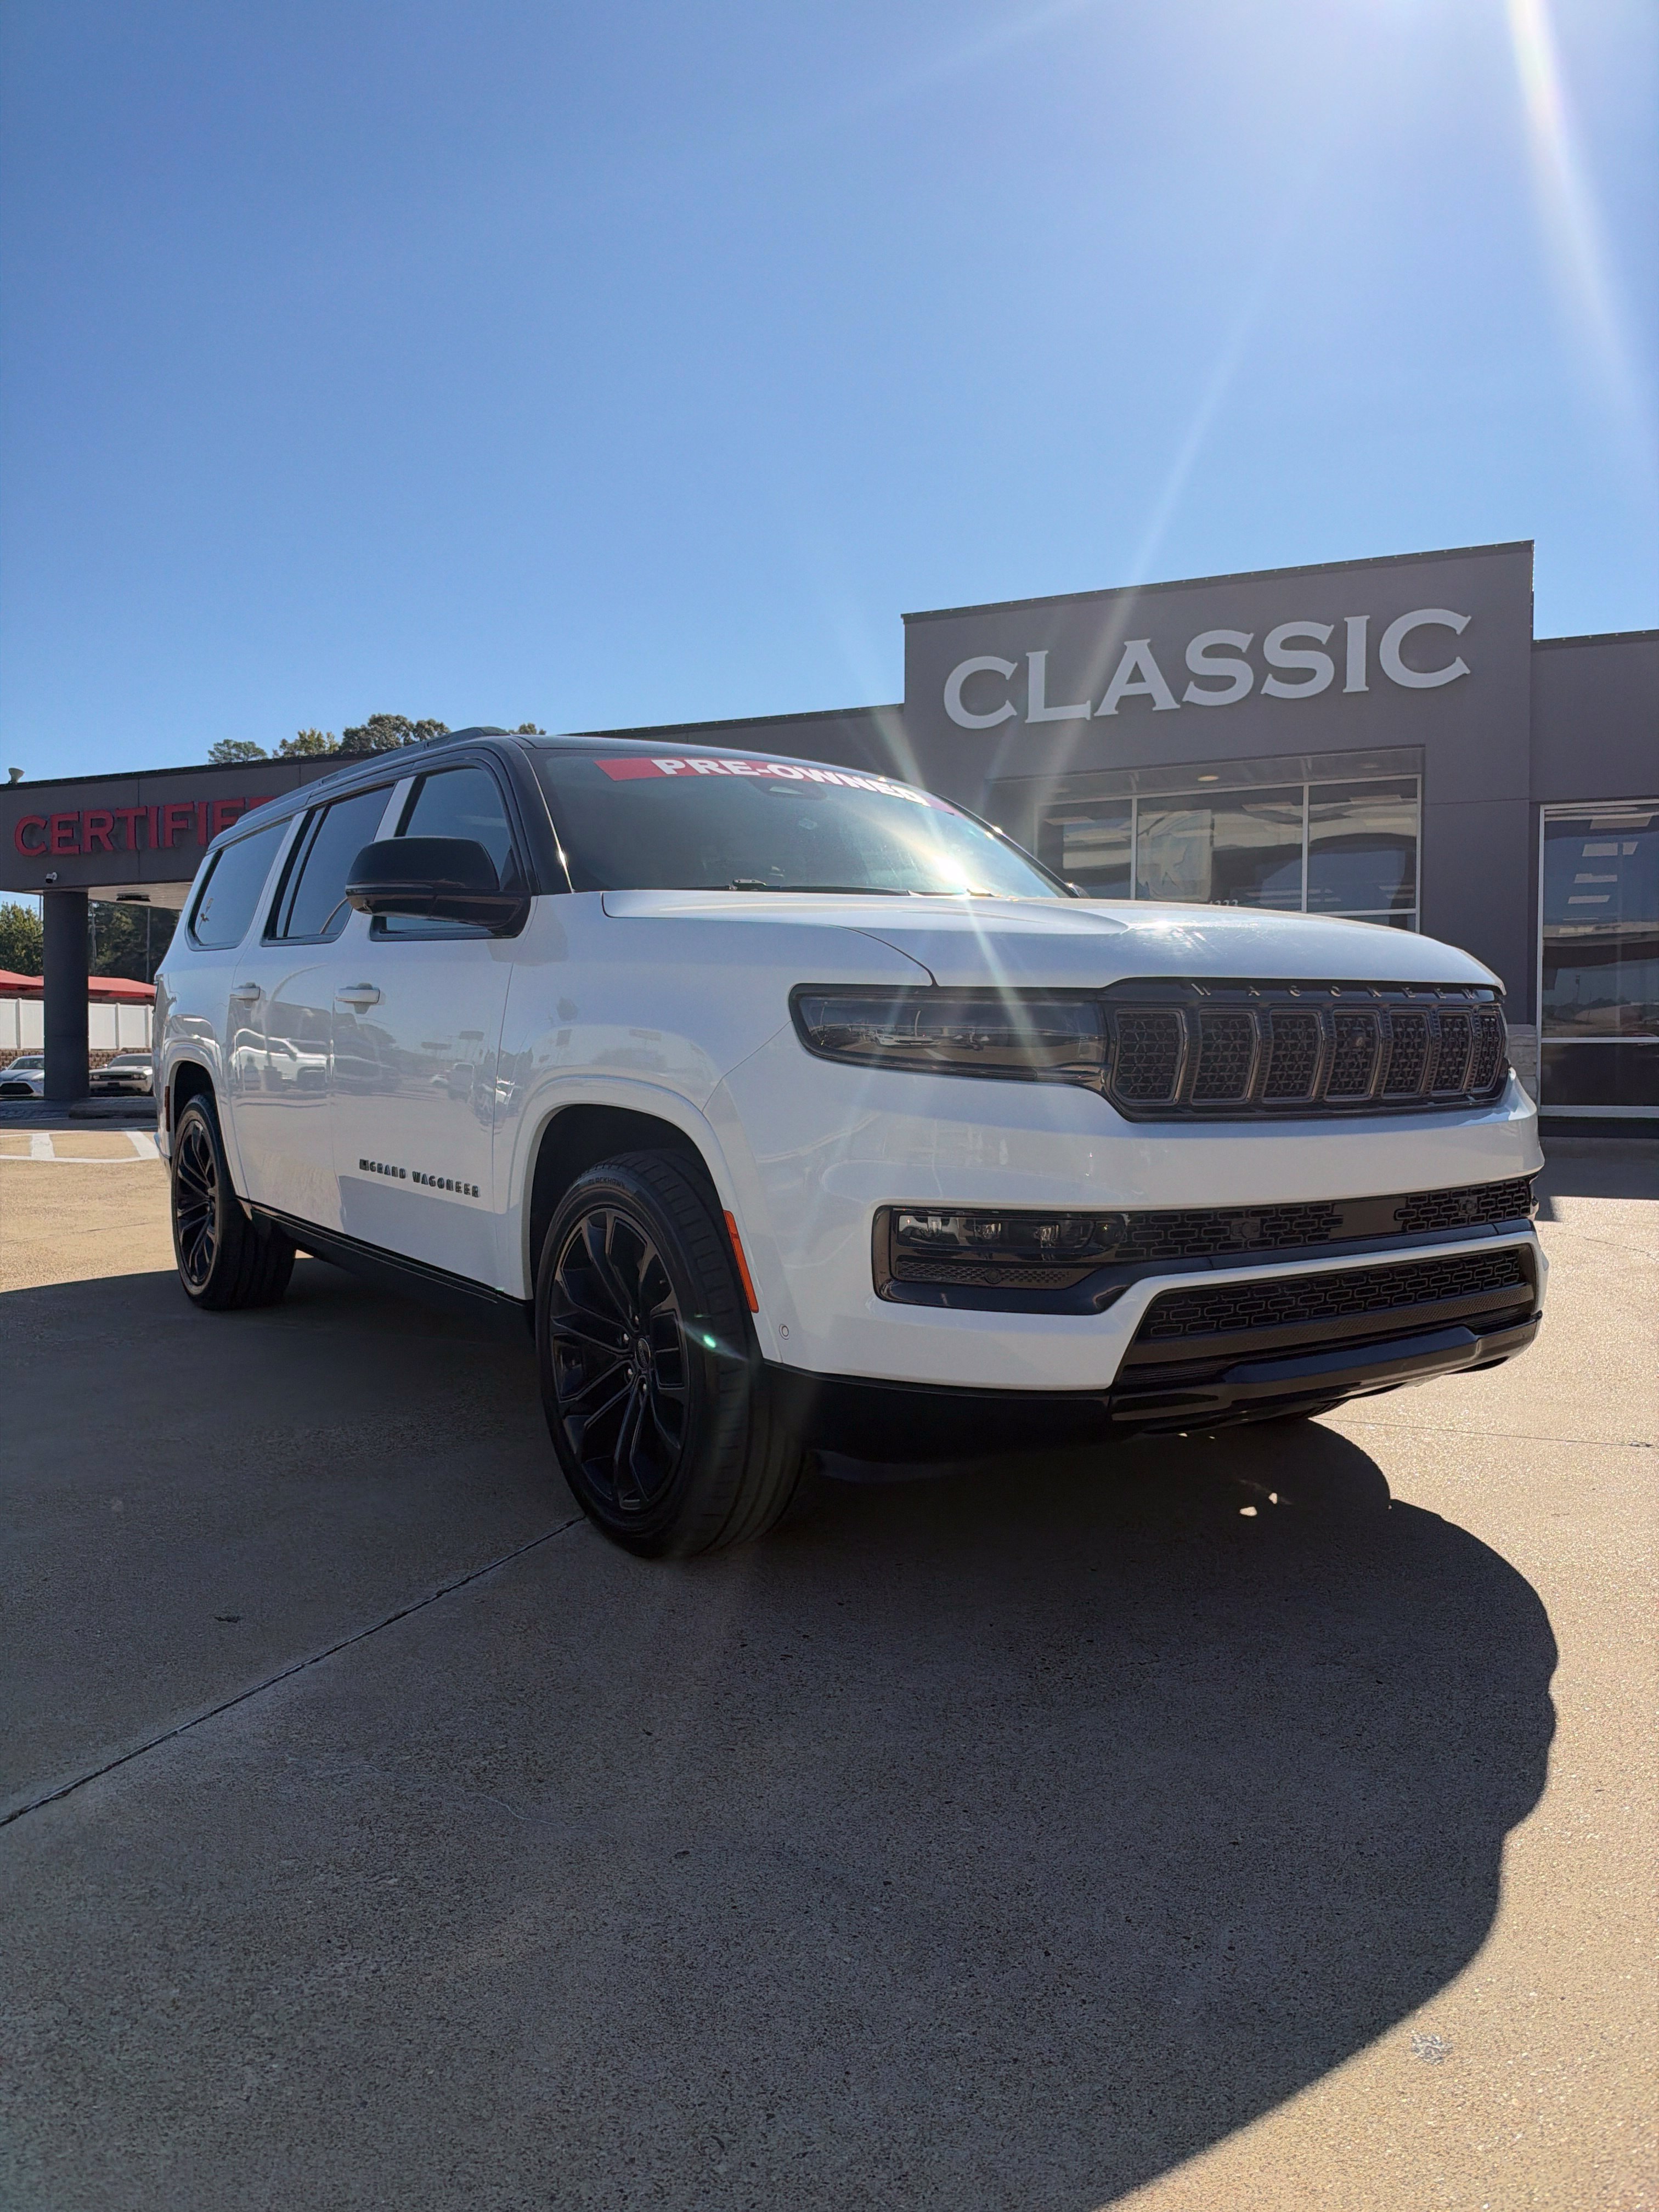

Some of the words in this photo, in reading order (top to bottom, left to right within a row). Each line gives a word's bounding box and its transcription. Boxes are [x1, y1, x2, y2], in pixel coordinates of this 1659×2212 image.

[944, 608, 1471, 729] CLASSIC
[651, 759, 931, 806] PRE-OWNED
[14, 795, 276, 856] CERTIFIE
[370, 1161, 406, 1179] GRAND
[412, 1171, 480, 1198] WAGONEER
